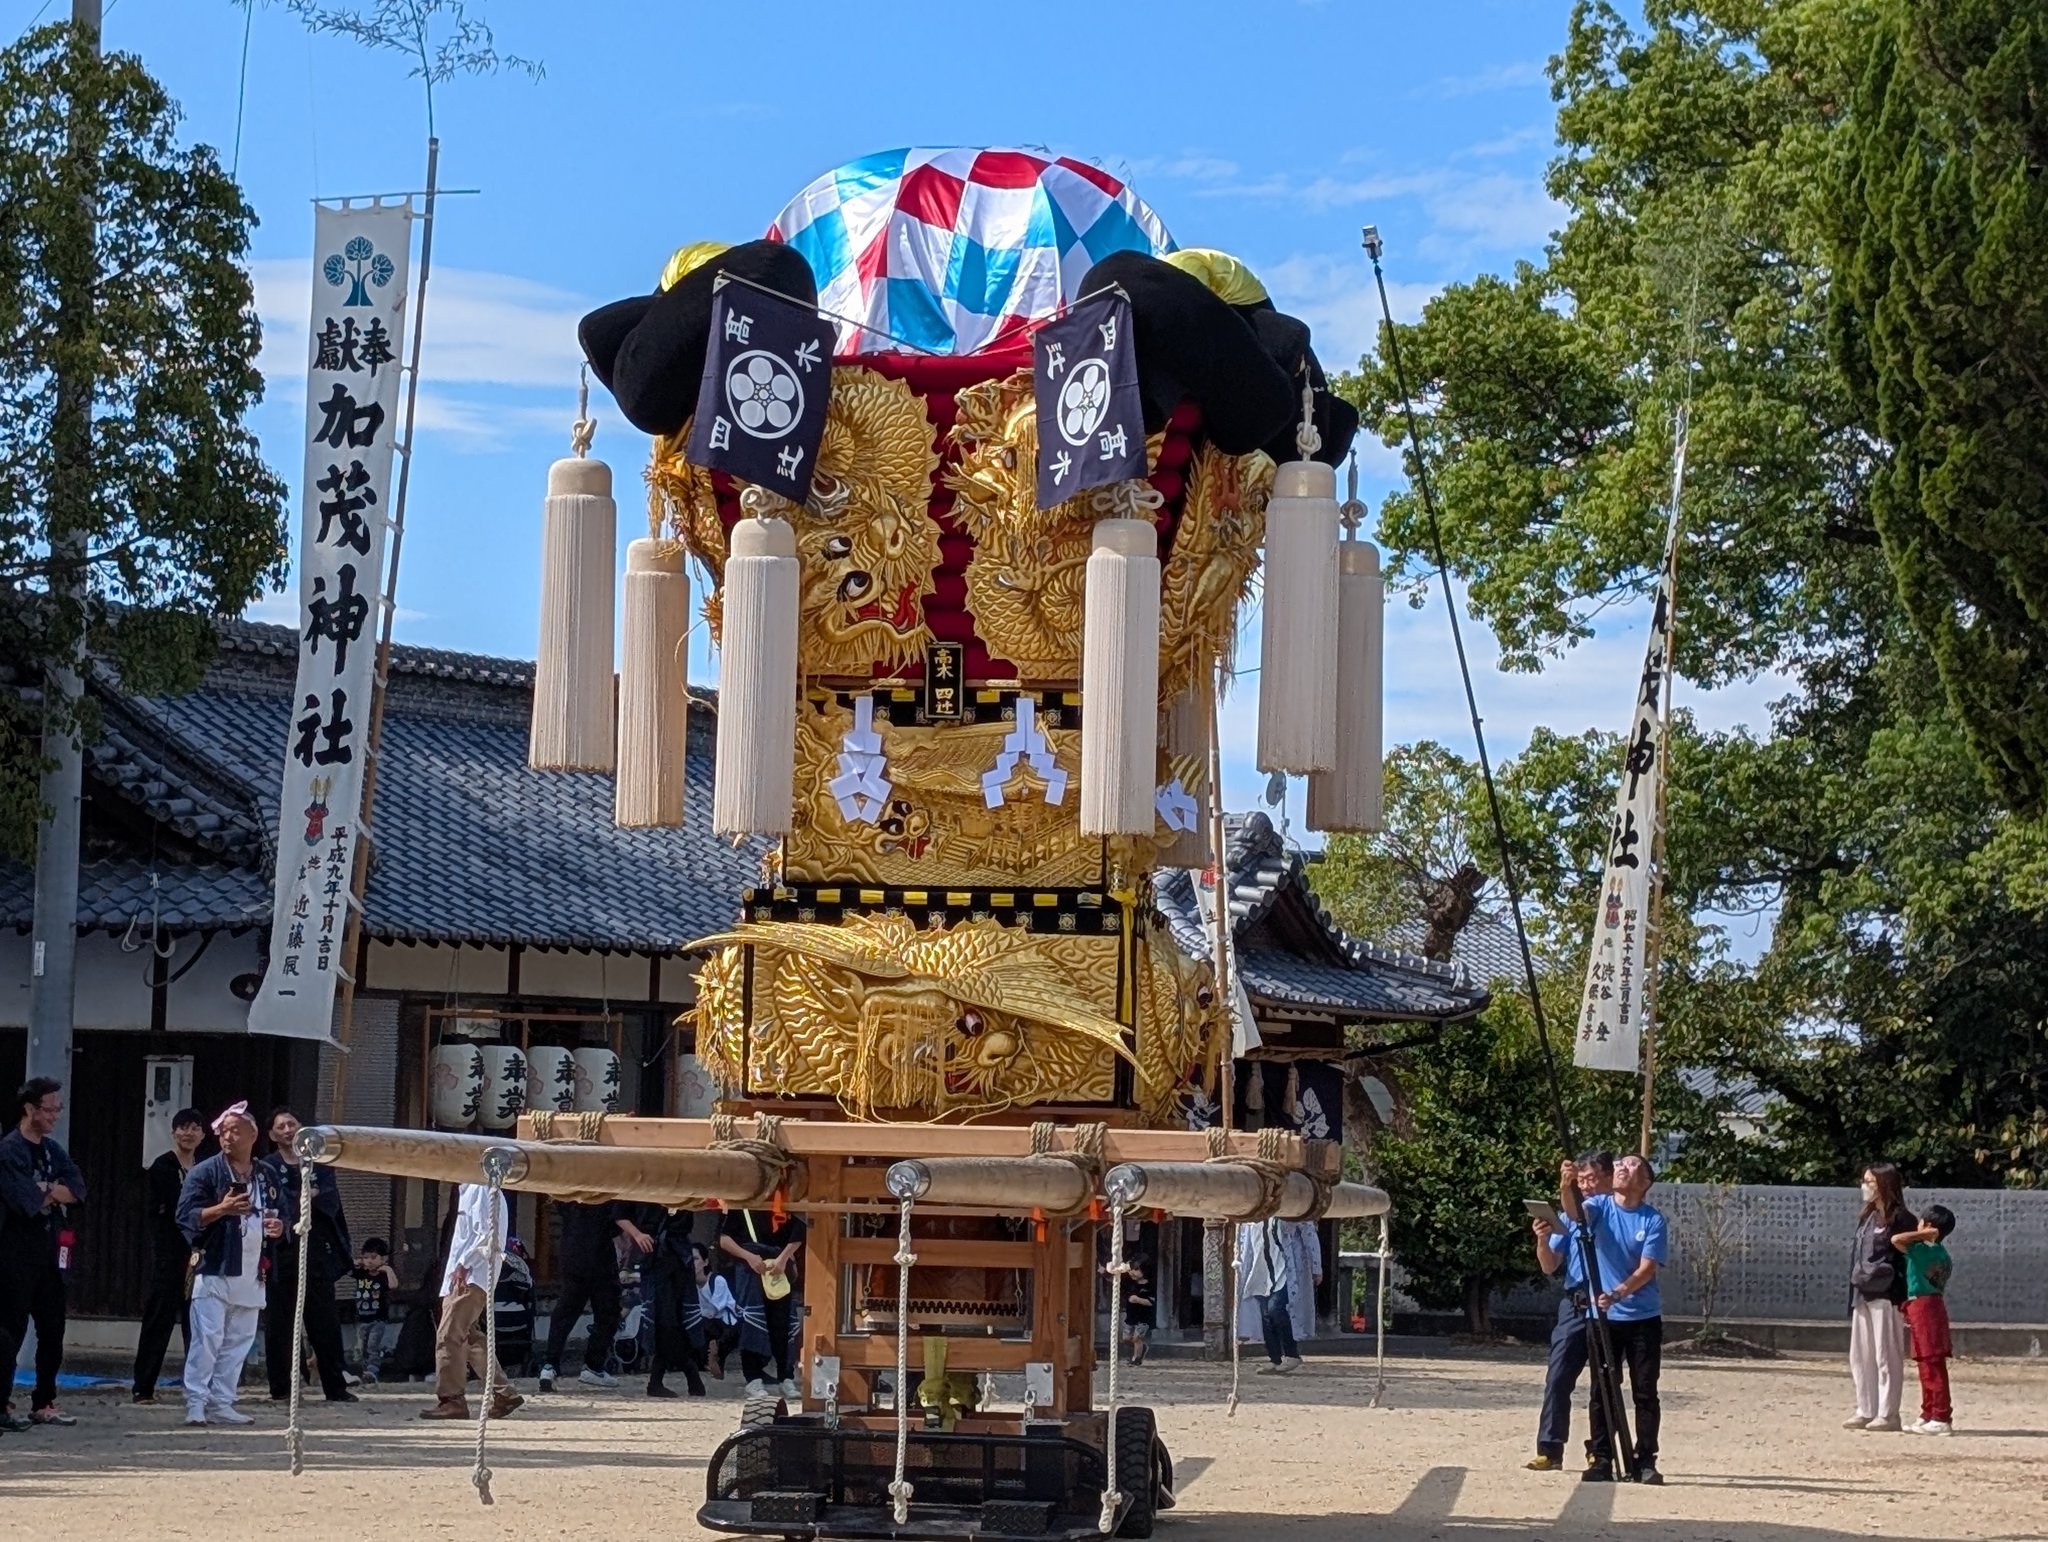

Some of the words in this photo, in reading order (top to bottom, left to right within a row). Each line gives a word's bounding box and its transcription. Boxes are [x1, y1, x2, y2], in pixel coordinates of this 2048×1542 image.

[294, 383, 385, 767] 加茂神社
[317, 826, 348, 971] 平成九年十月吉日
